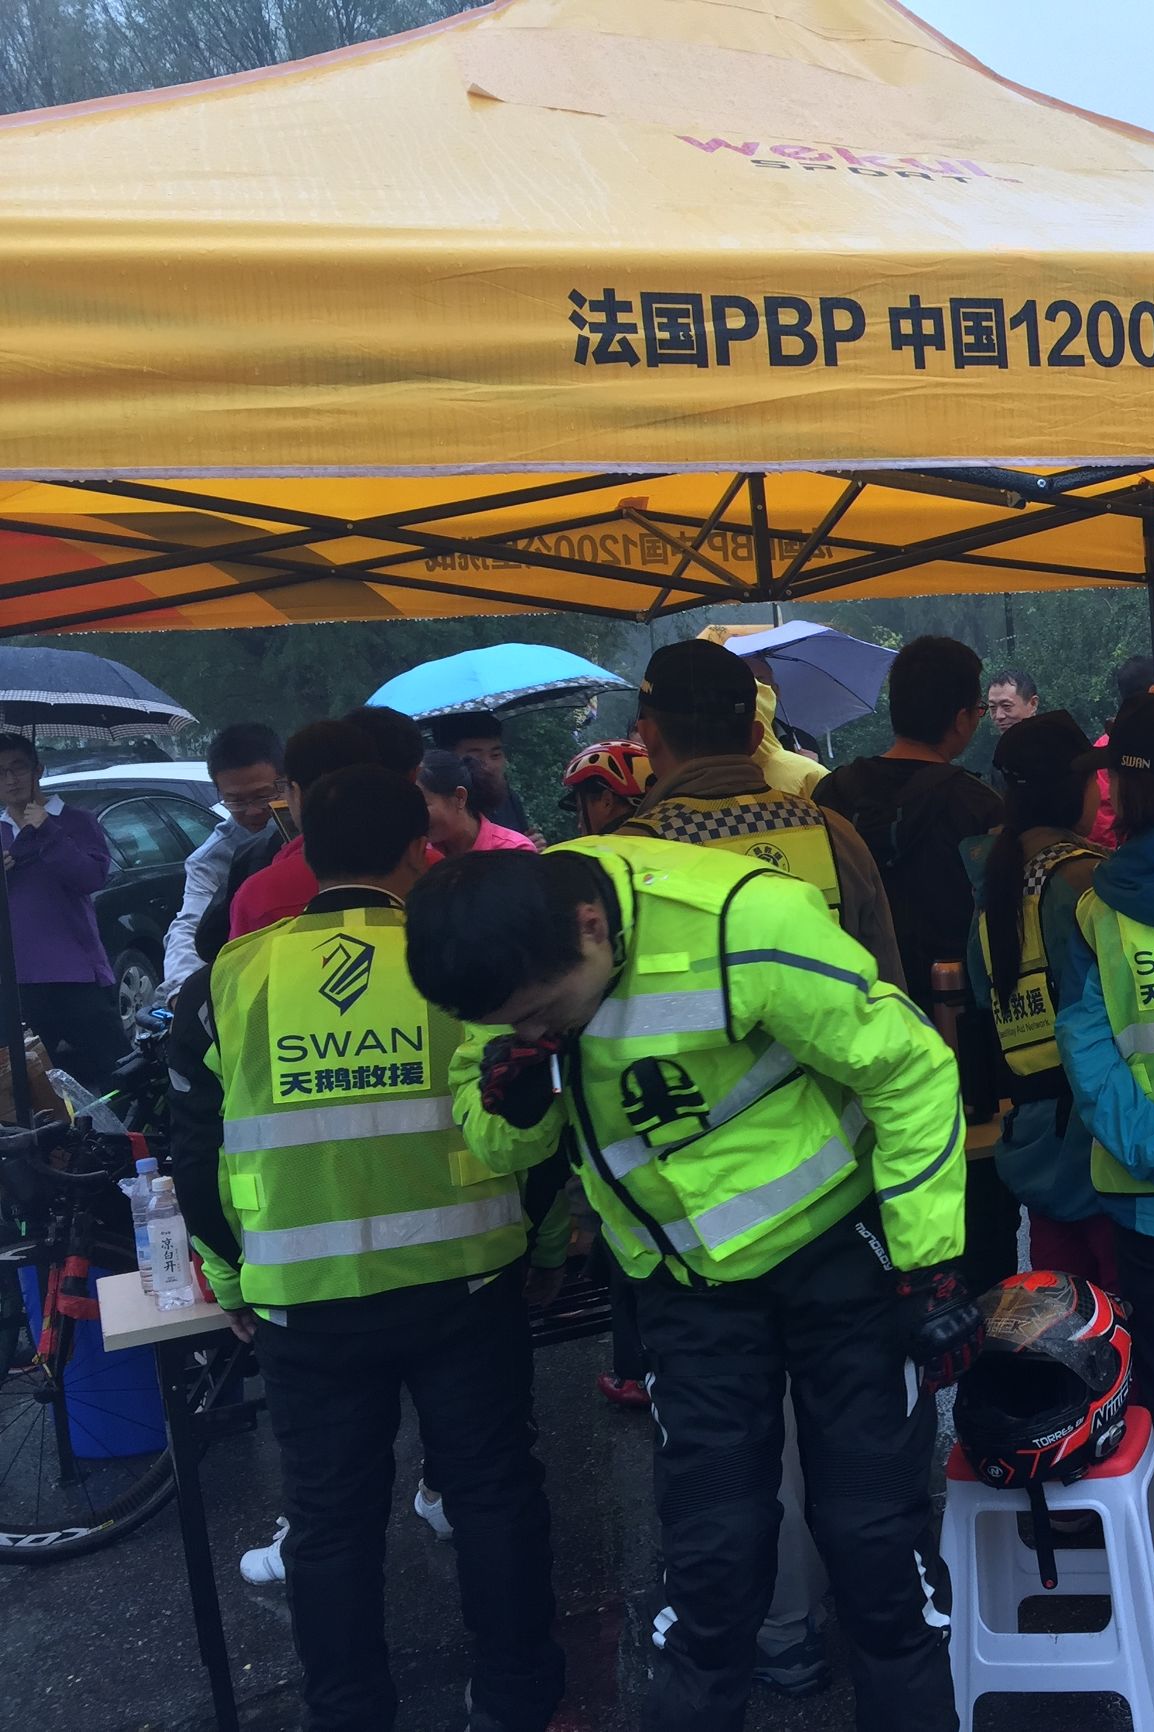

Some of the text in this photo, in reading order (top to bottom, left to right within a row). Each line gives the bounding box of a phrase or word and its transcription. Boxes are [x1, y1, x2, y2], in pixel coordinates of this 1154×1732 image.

[751, 159, 972, 184] SPORT
[568, 288, 866, 368] 法国PBP
[1121, 755, 1151, 769] SWAN
[276, 1025, 422, 1063] SWAN
[280, 1061, 424, 1097] 天鹅救援
[1032, 1425, 1074, 1448] TORRES
